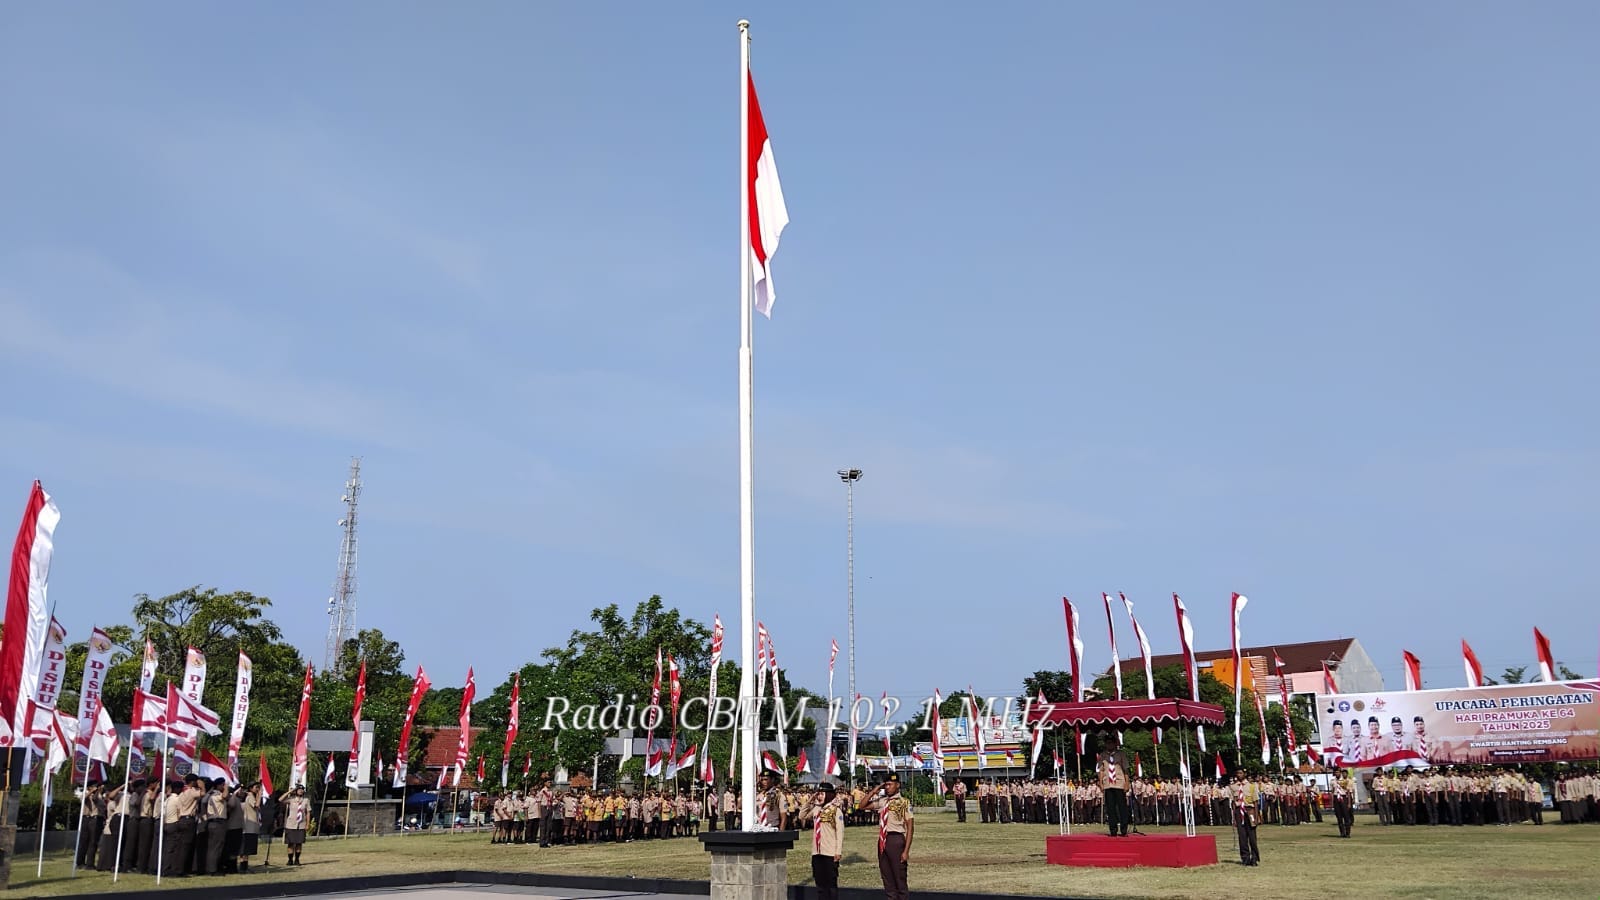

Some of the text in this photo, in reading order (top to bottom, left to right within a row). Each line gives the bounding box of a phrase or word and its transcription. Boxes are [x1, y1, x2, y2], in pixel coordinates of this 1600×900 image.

[38, 651, 64, 703] DISHU
[187, 674, 202, 701] DIS
[1435, 694, 1593, 711] UPACARA PERINGATAN
[1455, 708, 1574, 723] HARI PRAMUKA KE 64
[1482, 720, 1550, 732] TAHUN 2025
[1533, 738, 1567, 746] REMBANG
